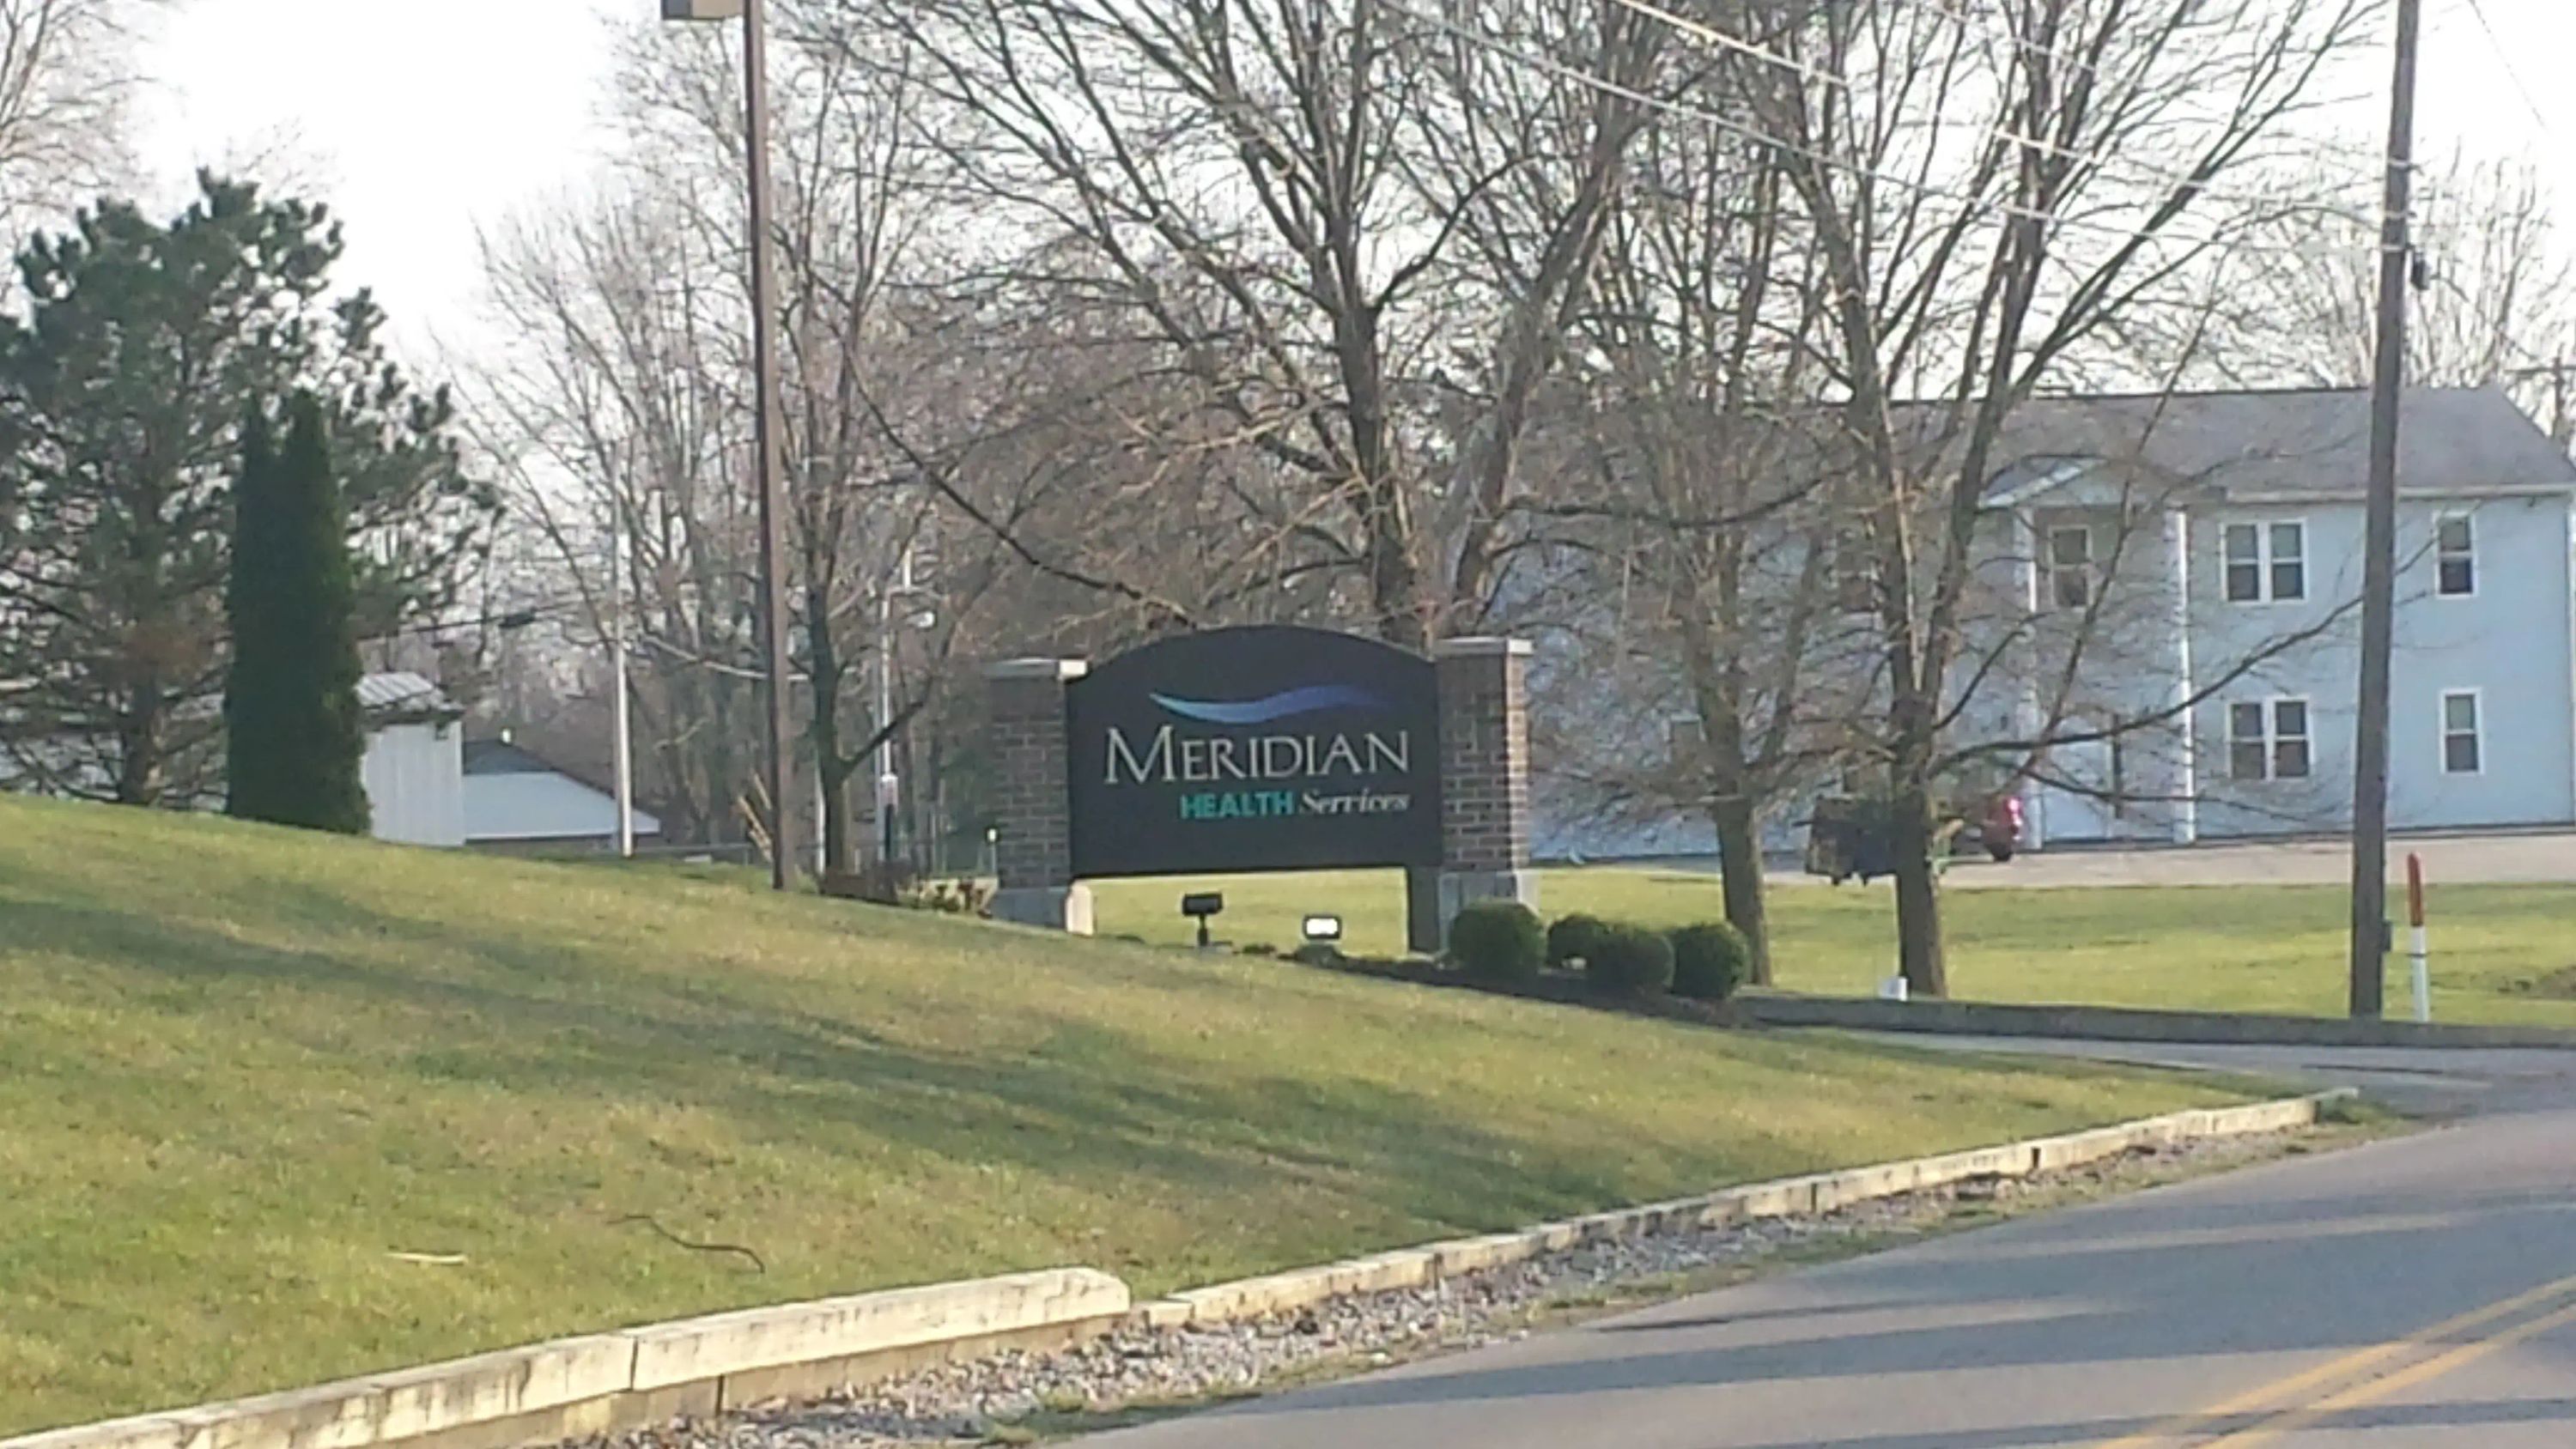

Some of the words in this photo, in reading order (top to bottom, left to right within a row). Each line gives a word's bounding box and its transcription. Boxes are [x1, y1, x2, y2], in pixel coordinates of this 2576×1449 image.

[1104, 725, 1409, 783] MERIDIAN
[1180, 791, 1294, 819] HEALTH
[1298, 787, 1410, 814] Services
